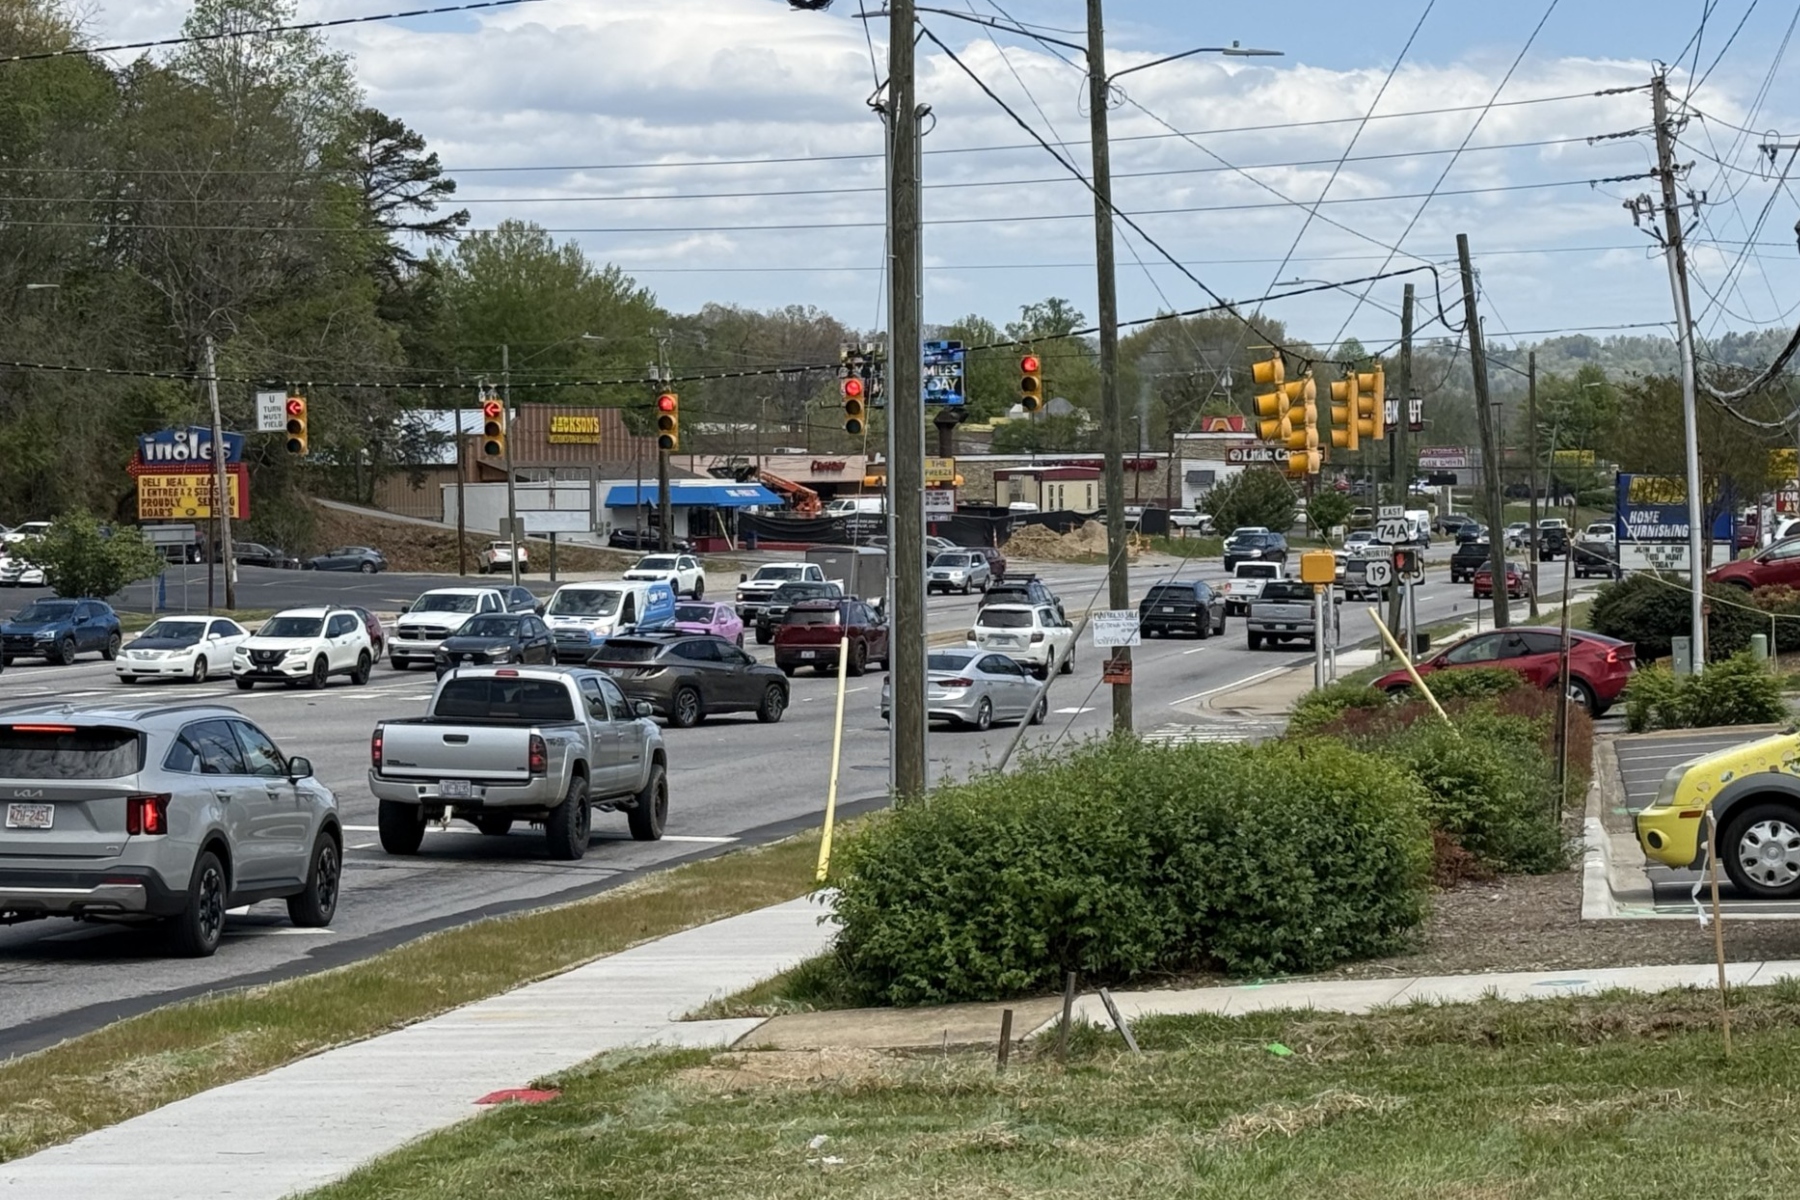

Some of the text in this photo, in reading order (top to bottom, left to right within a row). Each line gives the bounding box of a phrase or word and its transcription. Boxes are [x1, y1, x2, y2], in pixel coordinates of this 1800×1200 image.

[269, 395, 275, 403] U
[1408, 400, 1423, 424] UT
[194, 488, 221, 499] SIDS
[141, 497, 236, 508] PROUDLY SEVG
[141, 508, 174, 518] BOAR'S
[1382, 508, 1401, 516] EAST
[1629, 511, 1661, 523] HOME
[1378, 523, 1408, 539] 74A
[1366, 549, 1389, 558] NORTH
[1671, 546, 1685, 554] FOR
[1372, 566, 1387, 581] 19
[14, 789, 43, 797] KIA
